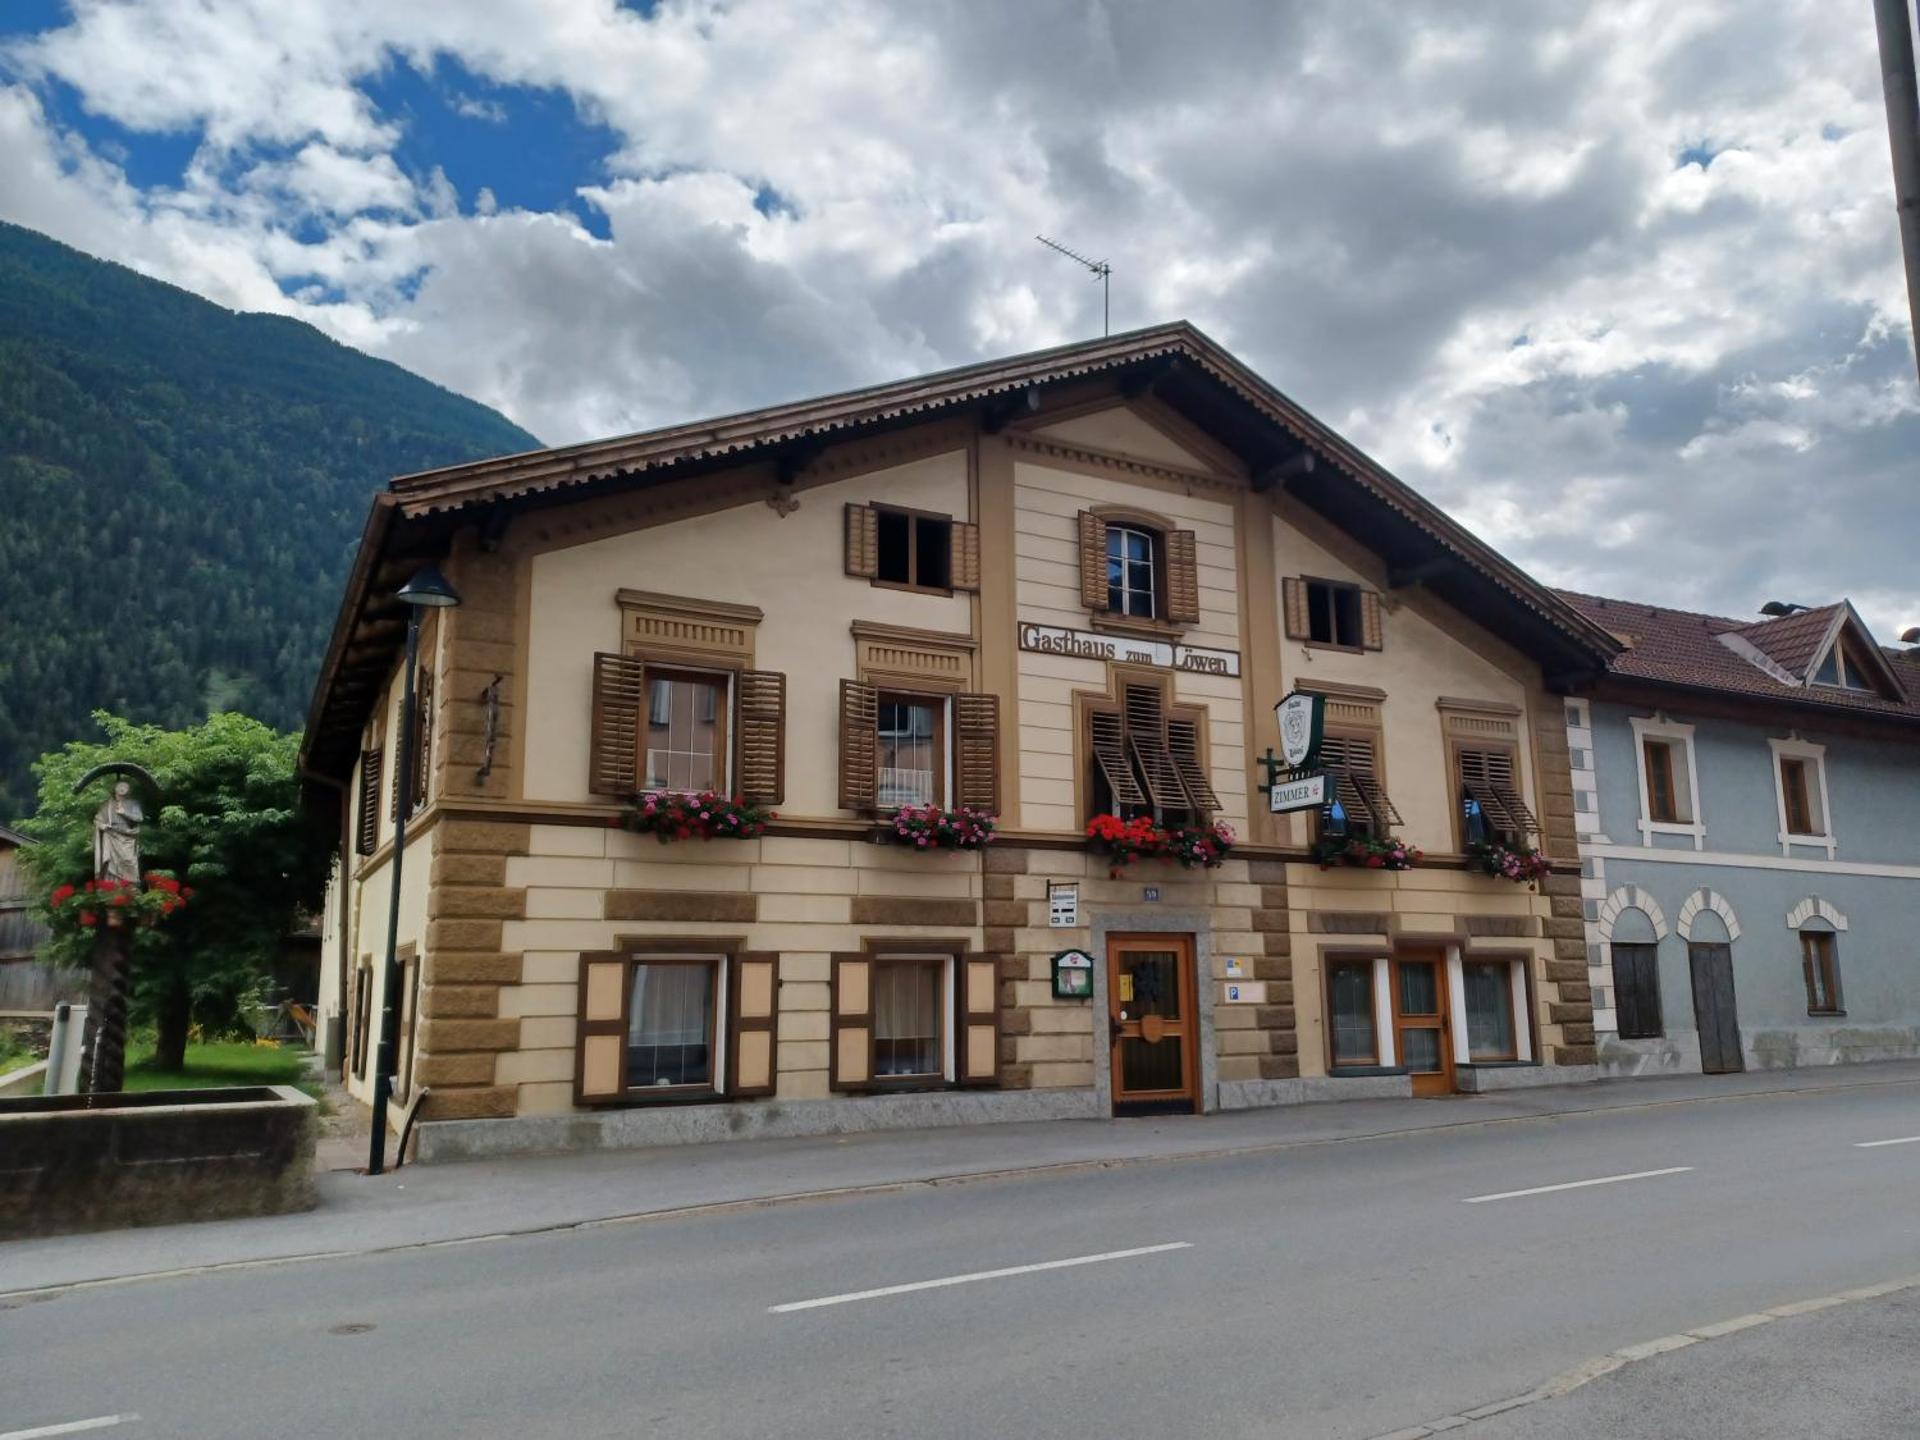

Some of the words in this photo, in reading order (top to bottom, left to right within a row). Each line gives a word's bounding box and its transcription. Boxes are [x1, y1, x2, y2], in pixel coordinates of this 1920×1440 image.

[1022, 625, 1115, 659] Gasthaus
[1126, 650, 1152, 664] zum
[1172, 644, 1228, 674] Löwen
[1275, 787, 1309, 804] ZIMMER
